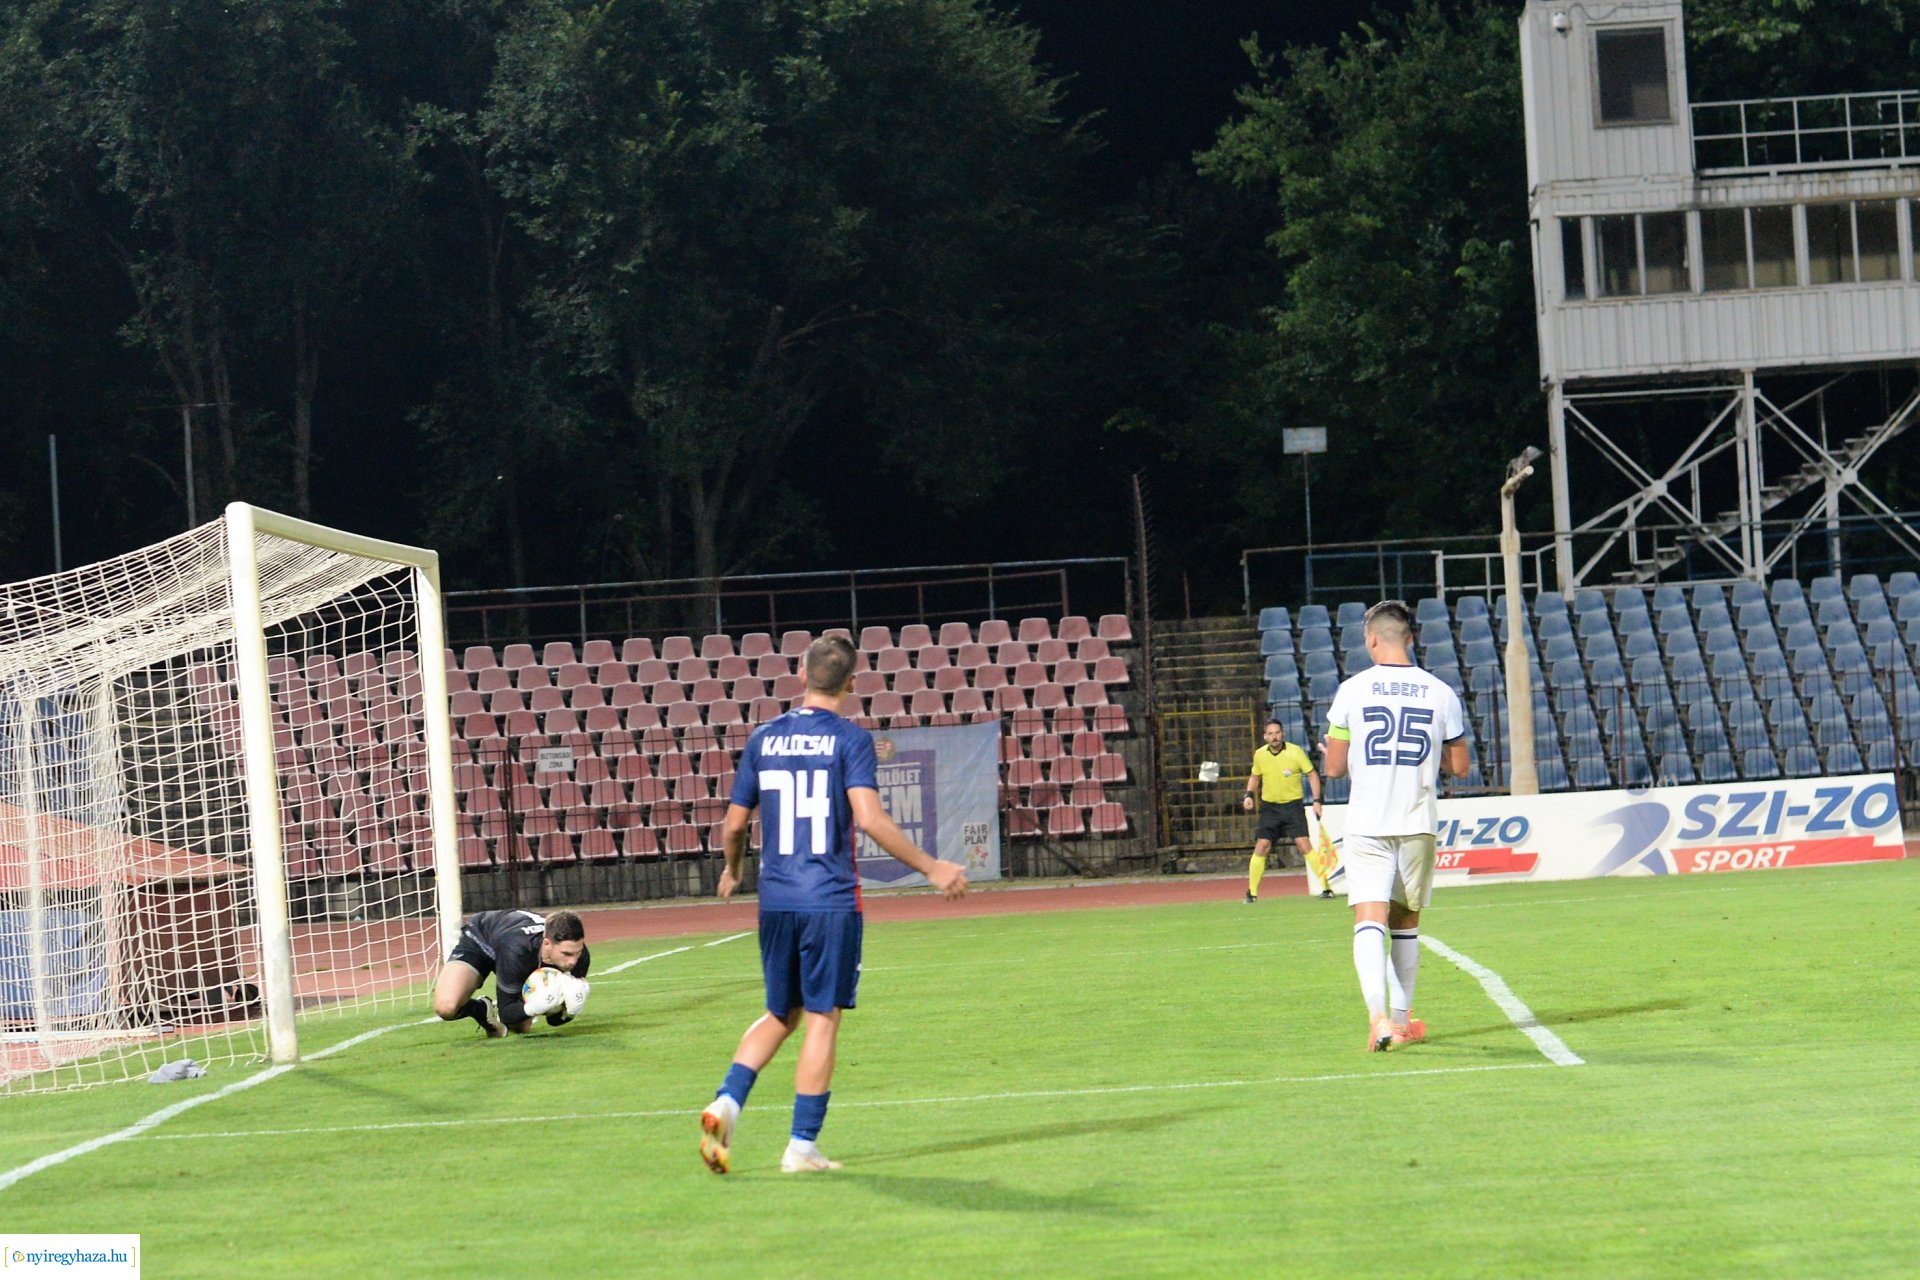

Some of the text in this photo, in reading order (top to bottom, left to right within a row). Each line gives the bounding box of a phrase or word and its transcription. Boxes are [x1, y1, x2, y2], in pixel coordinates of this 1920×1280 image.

[1372, 682, 1429, 698] ALBERT
[761, 734, 836, 756] KALOCSAI
[1363, 706, 1434, 767] 25
[758, 769, 830, 855] 74
[880, 784, 923, 824] EM
[1677, 782, 1899, 840] SZI-ZO
[964, 824, 988, 835] FAIR
[964, 835, 988, 845] PLAY
[1436, 815, 1529, 847] I-ZO
[1436, 852, 1465, 867] RT
[1690, 845, 1795, 872] SPORT
